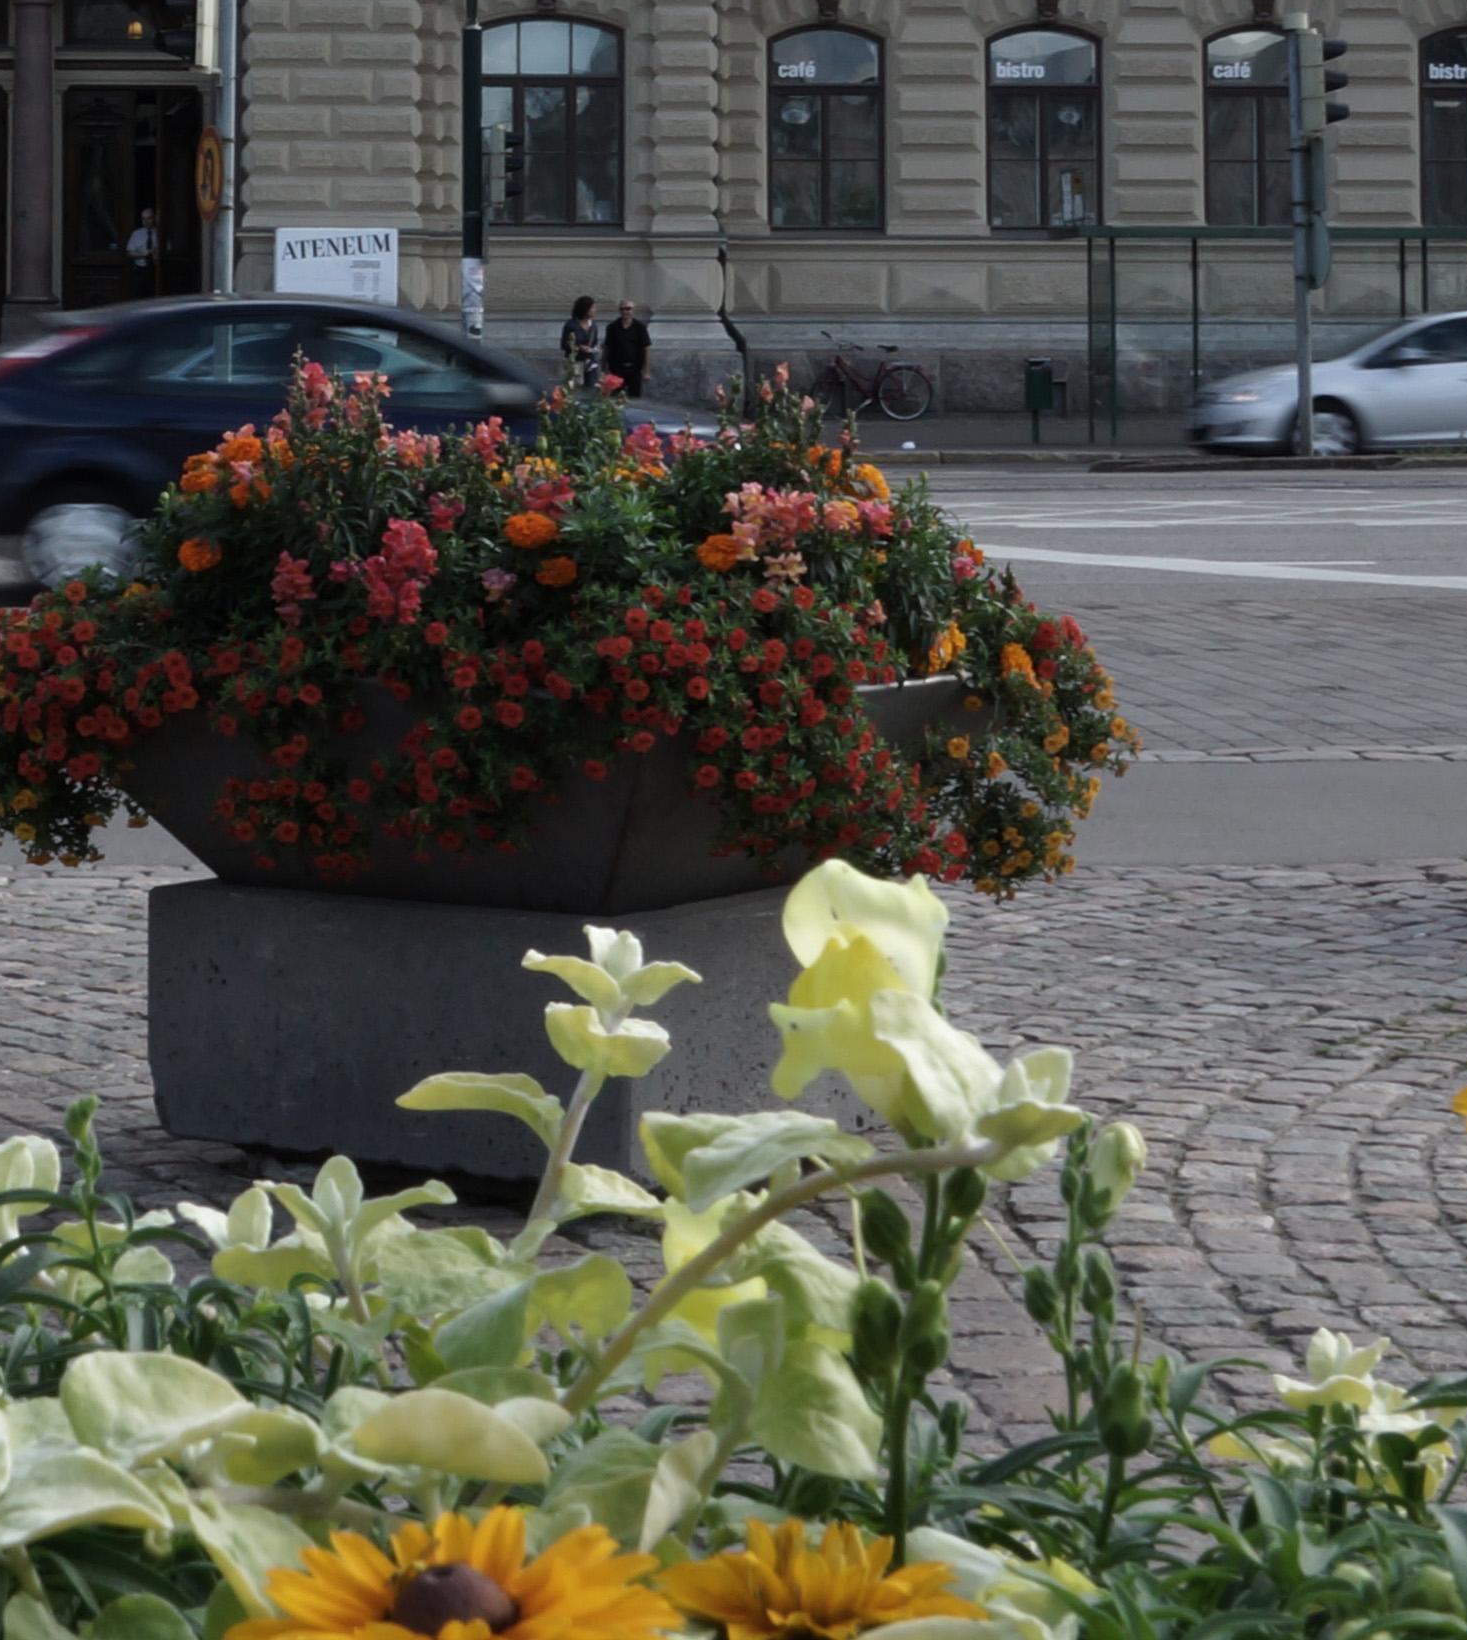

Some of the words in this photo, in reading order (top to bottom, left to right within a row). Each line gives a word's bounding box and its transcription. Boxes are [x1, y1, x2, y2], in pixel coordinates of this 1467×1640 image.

[777, 60, 816, 79] café
[995, 61, 1046, 79] bistro
[1212, 61, 1251, 79] café
[281, 232, 392, 261] ATENEUM
